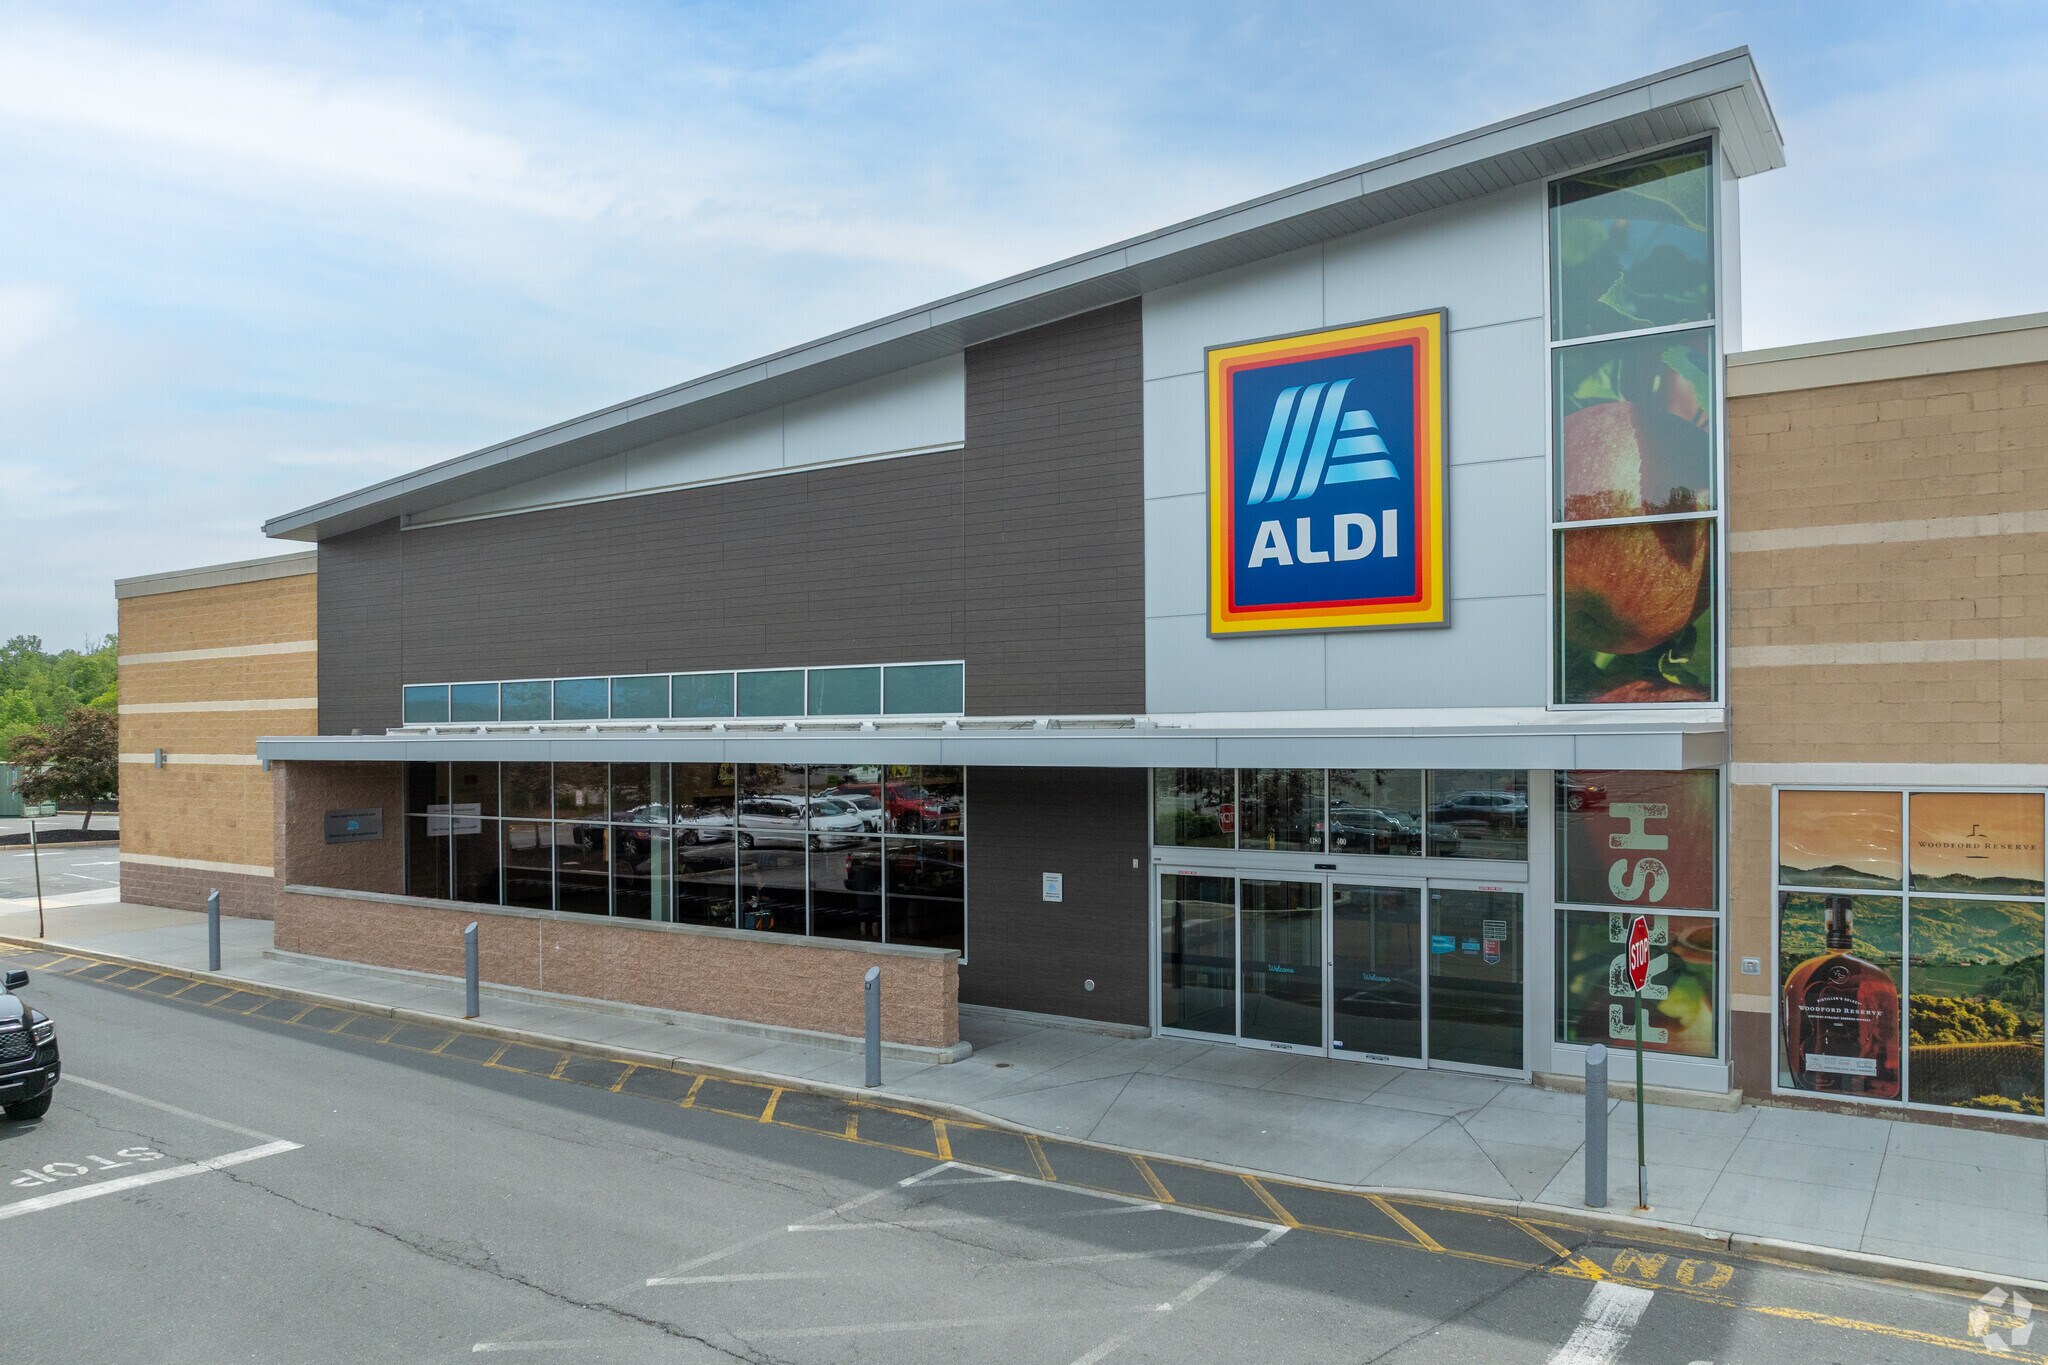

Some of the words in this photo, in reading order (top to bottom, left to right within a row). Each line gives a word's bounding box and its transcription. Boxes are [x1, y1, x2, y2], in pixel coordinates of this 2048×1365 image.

[1248, 509, 1398, 568] ALDI
[1918, 841, 1980, 849] WOODFORD
[1984, 843, 2037, 851] RESERVE
[1608, 802, 1669, 1044] FRESH
[1268, 964, 1294, 974] Welcome
[1631, 937, 1648, 970] STOP
[1362, 972, 1391, 982] Welcome
[1798, 1005, 1842, 1013] WOODFORD
[1843, 1007, 1881, 1016] RESERVE
[10, 1146, 165, 1188] STOP
[1611, 1246, 1734, 1289] NO
